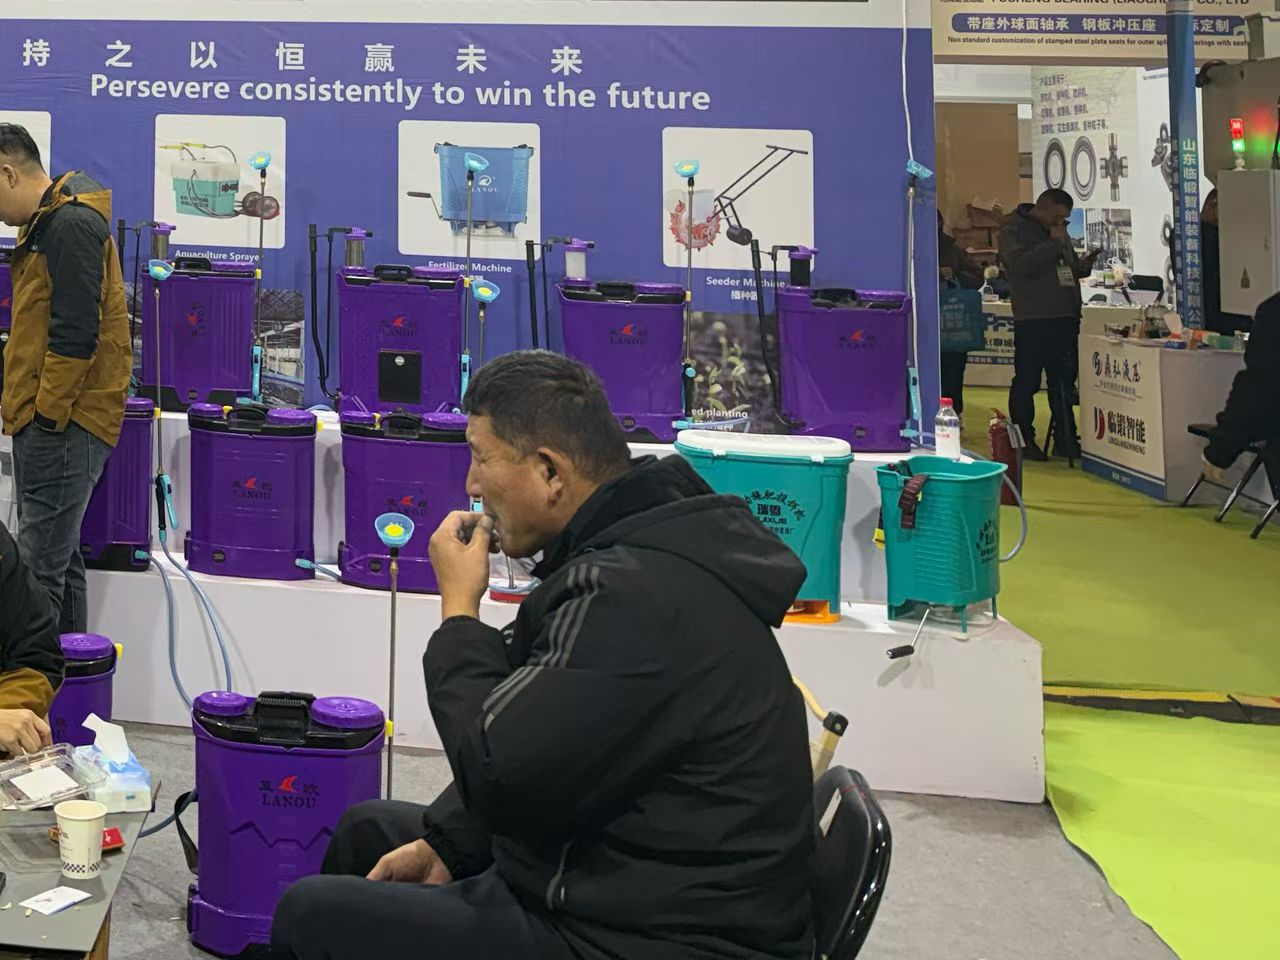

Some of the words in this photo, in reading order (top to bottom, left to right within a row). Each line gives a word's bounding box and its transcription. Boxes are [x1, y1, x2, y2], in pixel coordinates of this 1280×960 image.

[967, 17, 1069, 31] 带座外球面轴承
[1082, 18, 1157, 32] 钢板冲压座
[1044, 38, 1072, 46] stamped
[1091, 38, 1108, 46] plate
[22, 39, 583, 75] 持之以恒赢未来
[91, 73, 230, 100] Persevere
[239, 77, 423, 111] consistently
[432, 81, 465, 105] to
[475, 80, 532, 107] win
[542, 81, 596, 108] the
[607, 82, 711, 111] future
[175, 250, 228, 261] Aquaculture
[472, 262, 512, 273] Machine
[706, 276, 740, 287] Seeder
[261, 794, 317, 809] LANOU
